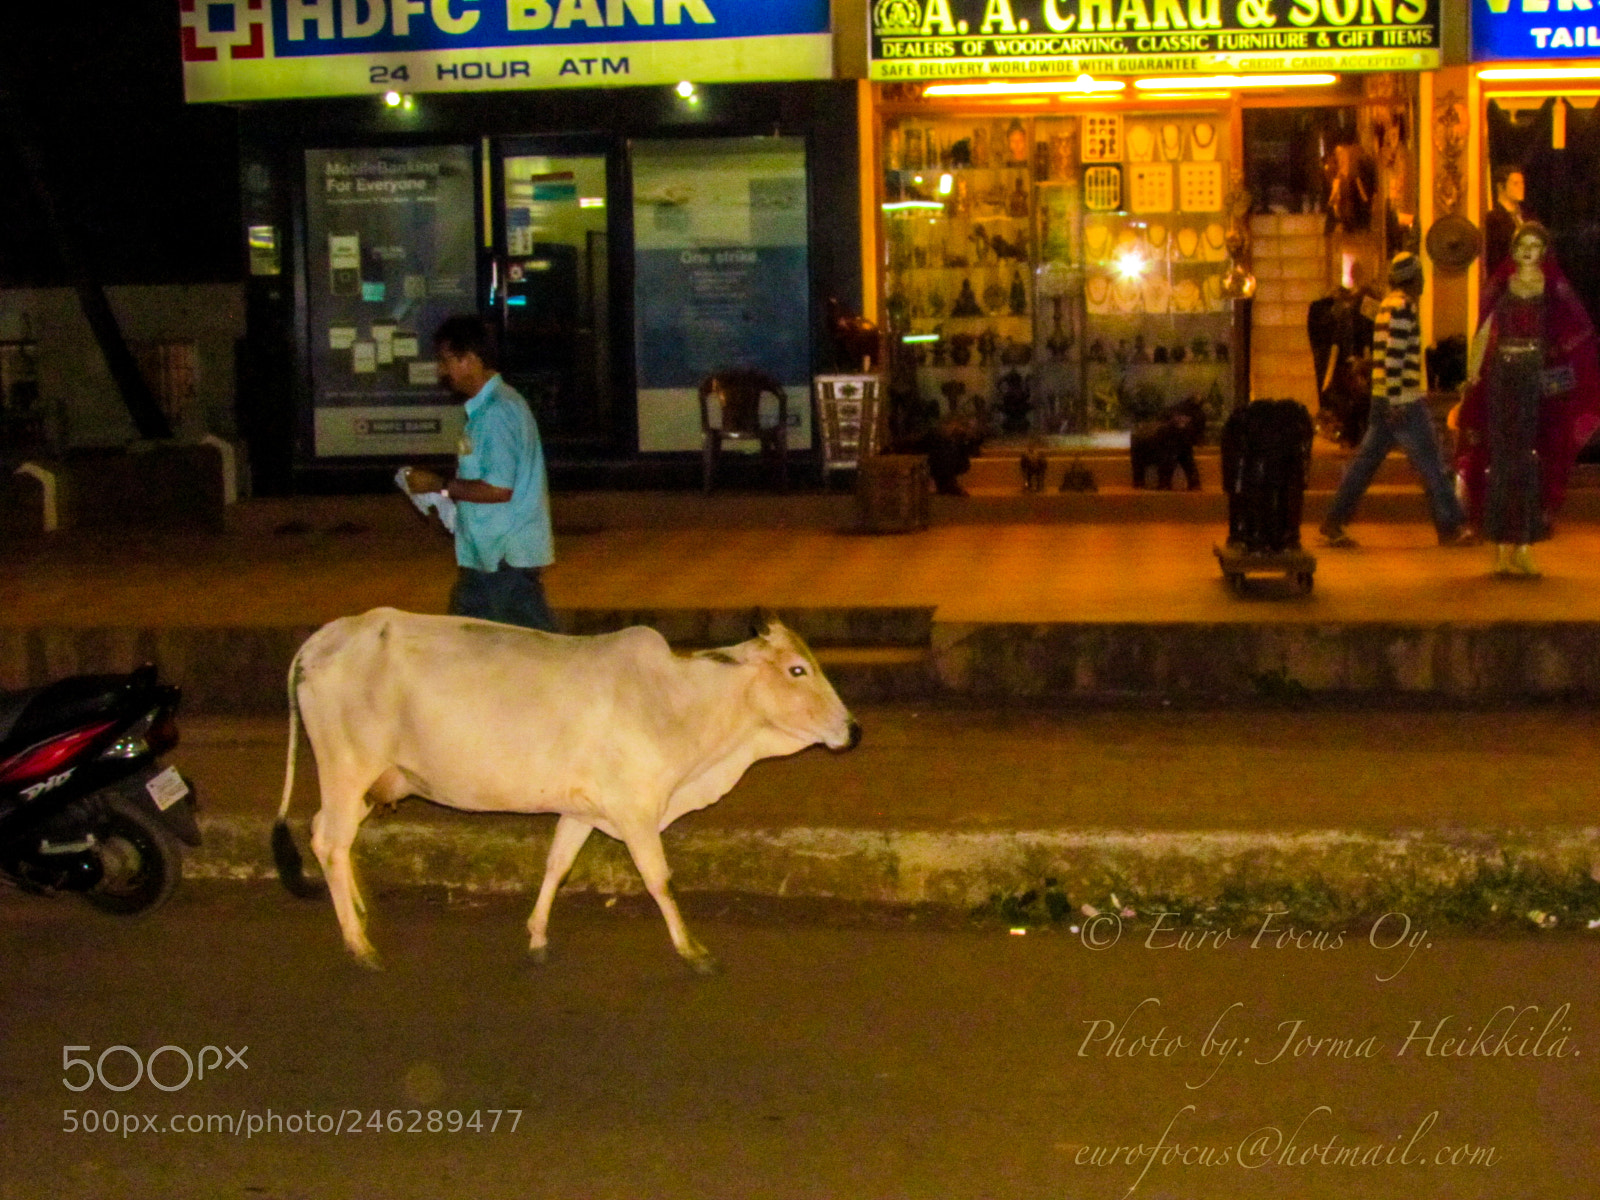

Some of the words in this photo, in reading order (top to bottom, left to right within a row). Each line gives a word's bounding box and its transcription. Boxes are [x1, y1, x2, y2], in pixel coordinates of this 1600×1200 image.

[286, 0, 481, 42] HDFC
[881, 40, 956, 58] DEALERS
[961, 40, 987, 57] OF
[993, 36, 1129, 56] WOODCARVING,
[1136, 34, 1210, 52] CLASSIC
[1216, 32, 1309, 51] FURNITURE
[1315, 31, 1331, 48] &
[1337, 30, 1375, 47] GIFT
[1382, 29, 1433, 46] ITEMS
[369, 65, 410, 84] 24
[436, 60, 531, 81] HOUR
[558, 56, 630, 76] ATM
[880, 63, 914, 77] SAFE
[919, 61, 984, 76] DELIVERY
[988, 59, 1074, 75] WORLDWIDE
[1078, 58, 1114, 73] WITH
[1118, 57, 1198, 71] GUARANTEE
[1238, 57, 1286, 71] CREDIT
[1291, 56, 1335, 70] CARDS
[1339, 55, 1407, 70] ACCEPTED
[356, 177, 427, 194] Everyone
